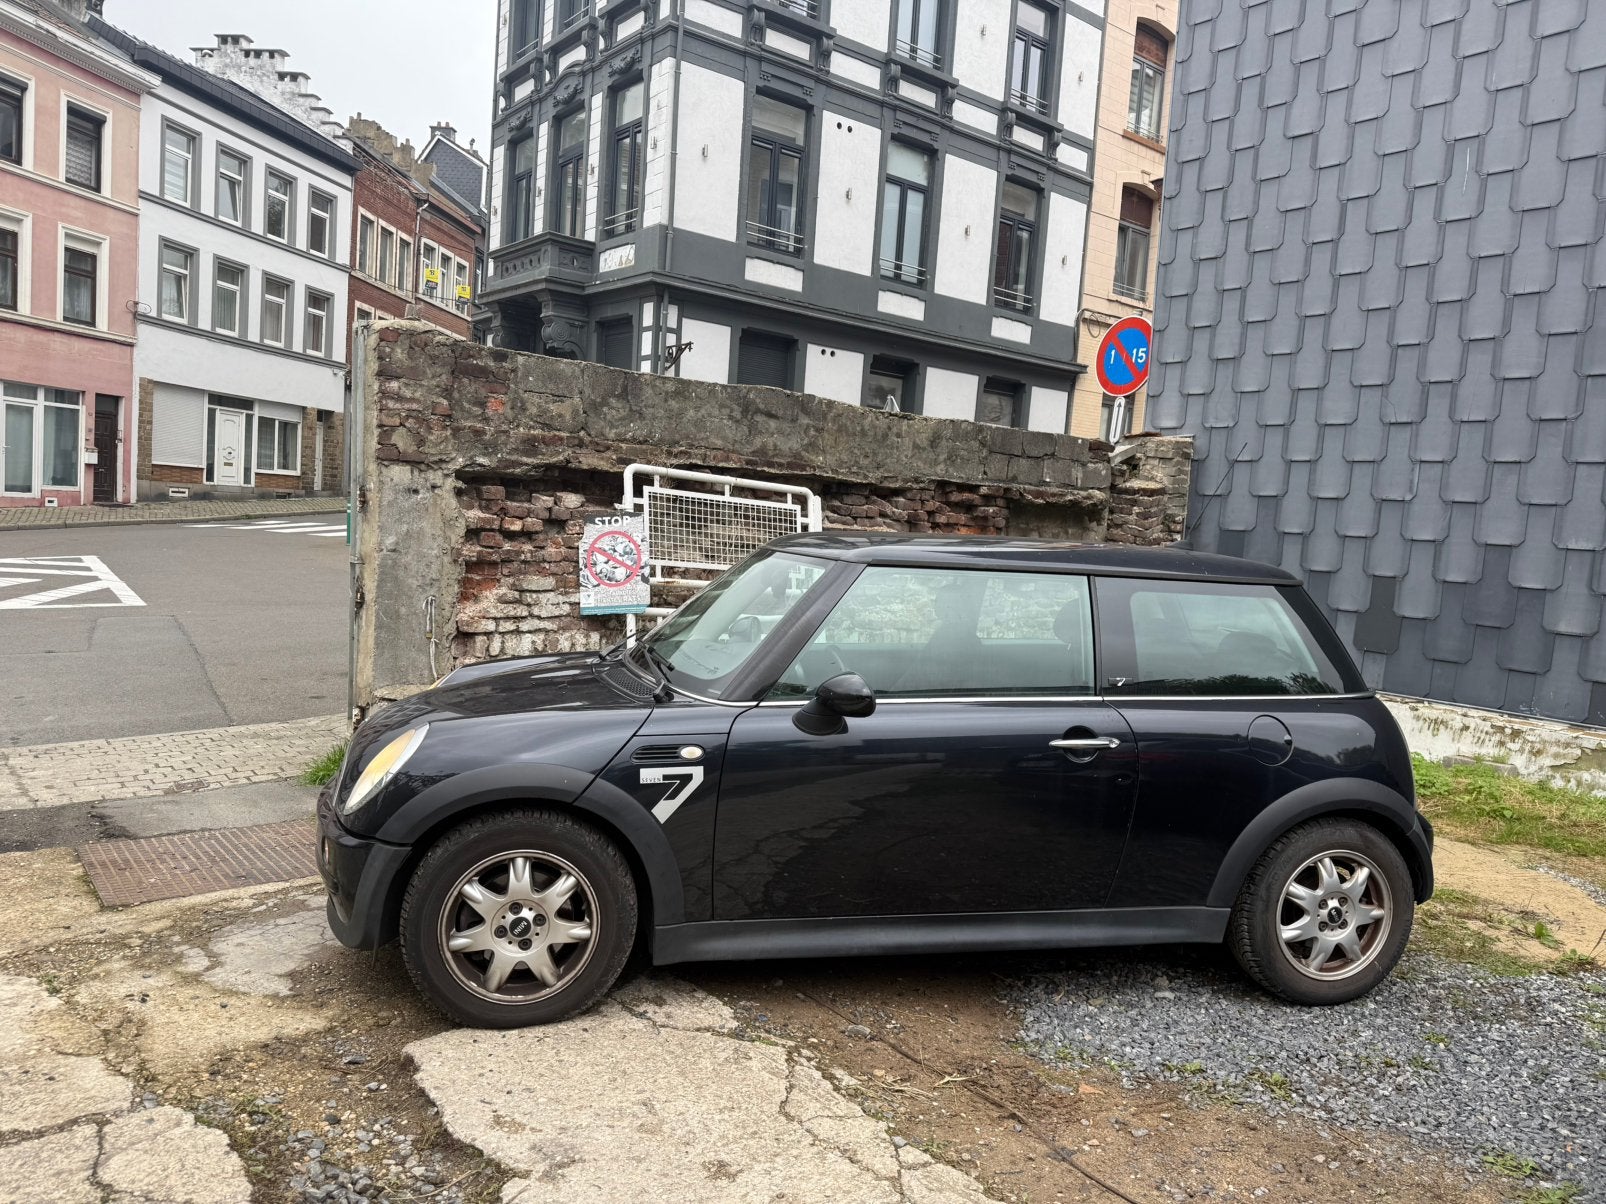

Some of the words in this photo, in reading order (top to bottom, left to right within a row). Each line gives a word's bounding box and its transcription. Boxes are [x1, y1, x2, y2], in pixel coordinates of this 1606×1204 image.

[1110, 349, 1116, 364] 1
[1132, 347, 1147, 364] 15
[594, 515, 632, 528] STOP
[639, 765, 704, 824] 7
[513, 920, 528, 935] MINI
